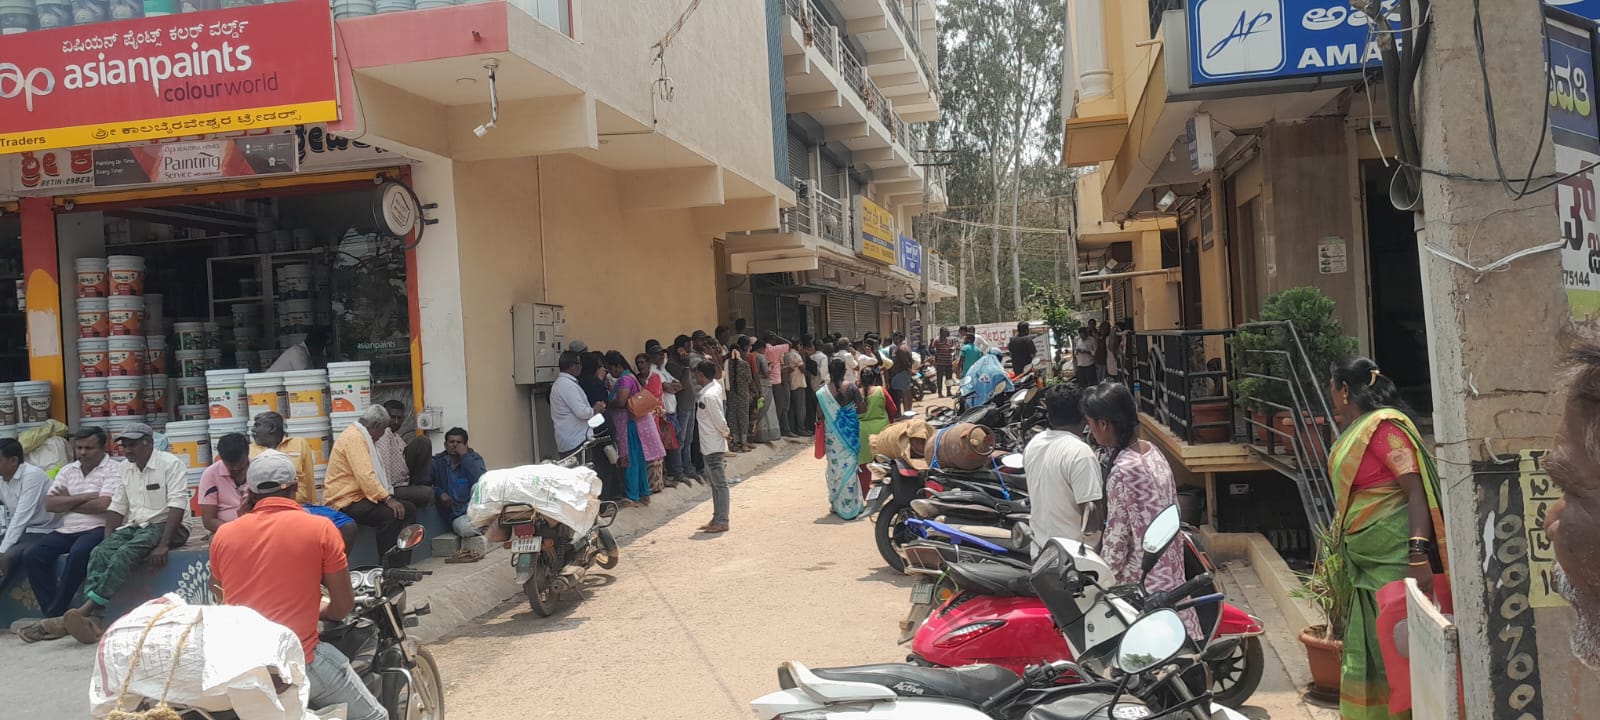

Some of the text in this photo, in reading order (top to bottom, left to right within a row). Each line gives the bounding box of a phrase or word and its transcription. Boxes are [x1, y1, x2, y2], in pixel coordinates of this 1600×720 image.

[169, 23, 204, 41] ಕಲರ್
[63, 41, 252, 98] asianpaints
[91, 128, 117, 140] ಶ್ರೀ
[0, 136, 46, 148] Traders
[164, 152, 220, 171] Painting
[165, 171, 192, 180] Service
[357, 340, 396, 352] asianpaints
[893, 681, 925, 696] Activa
